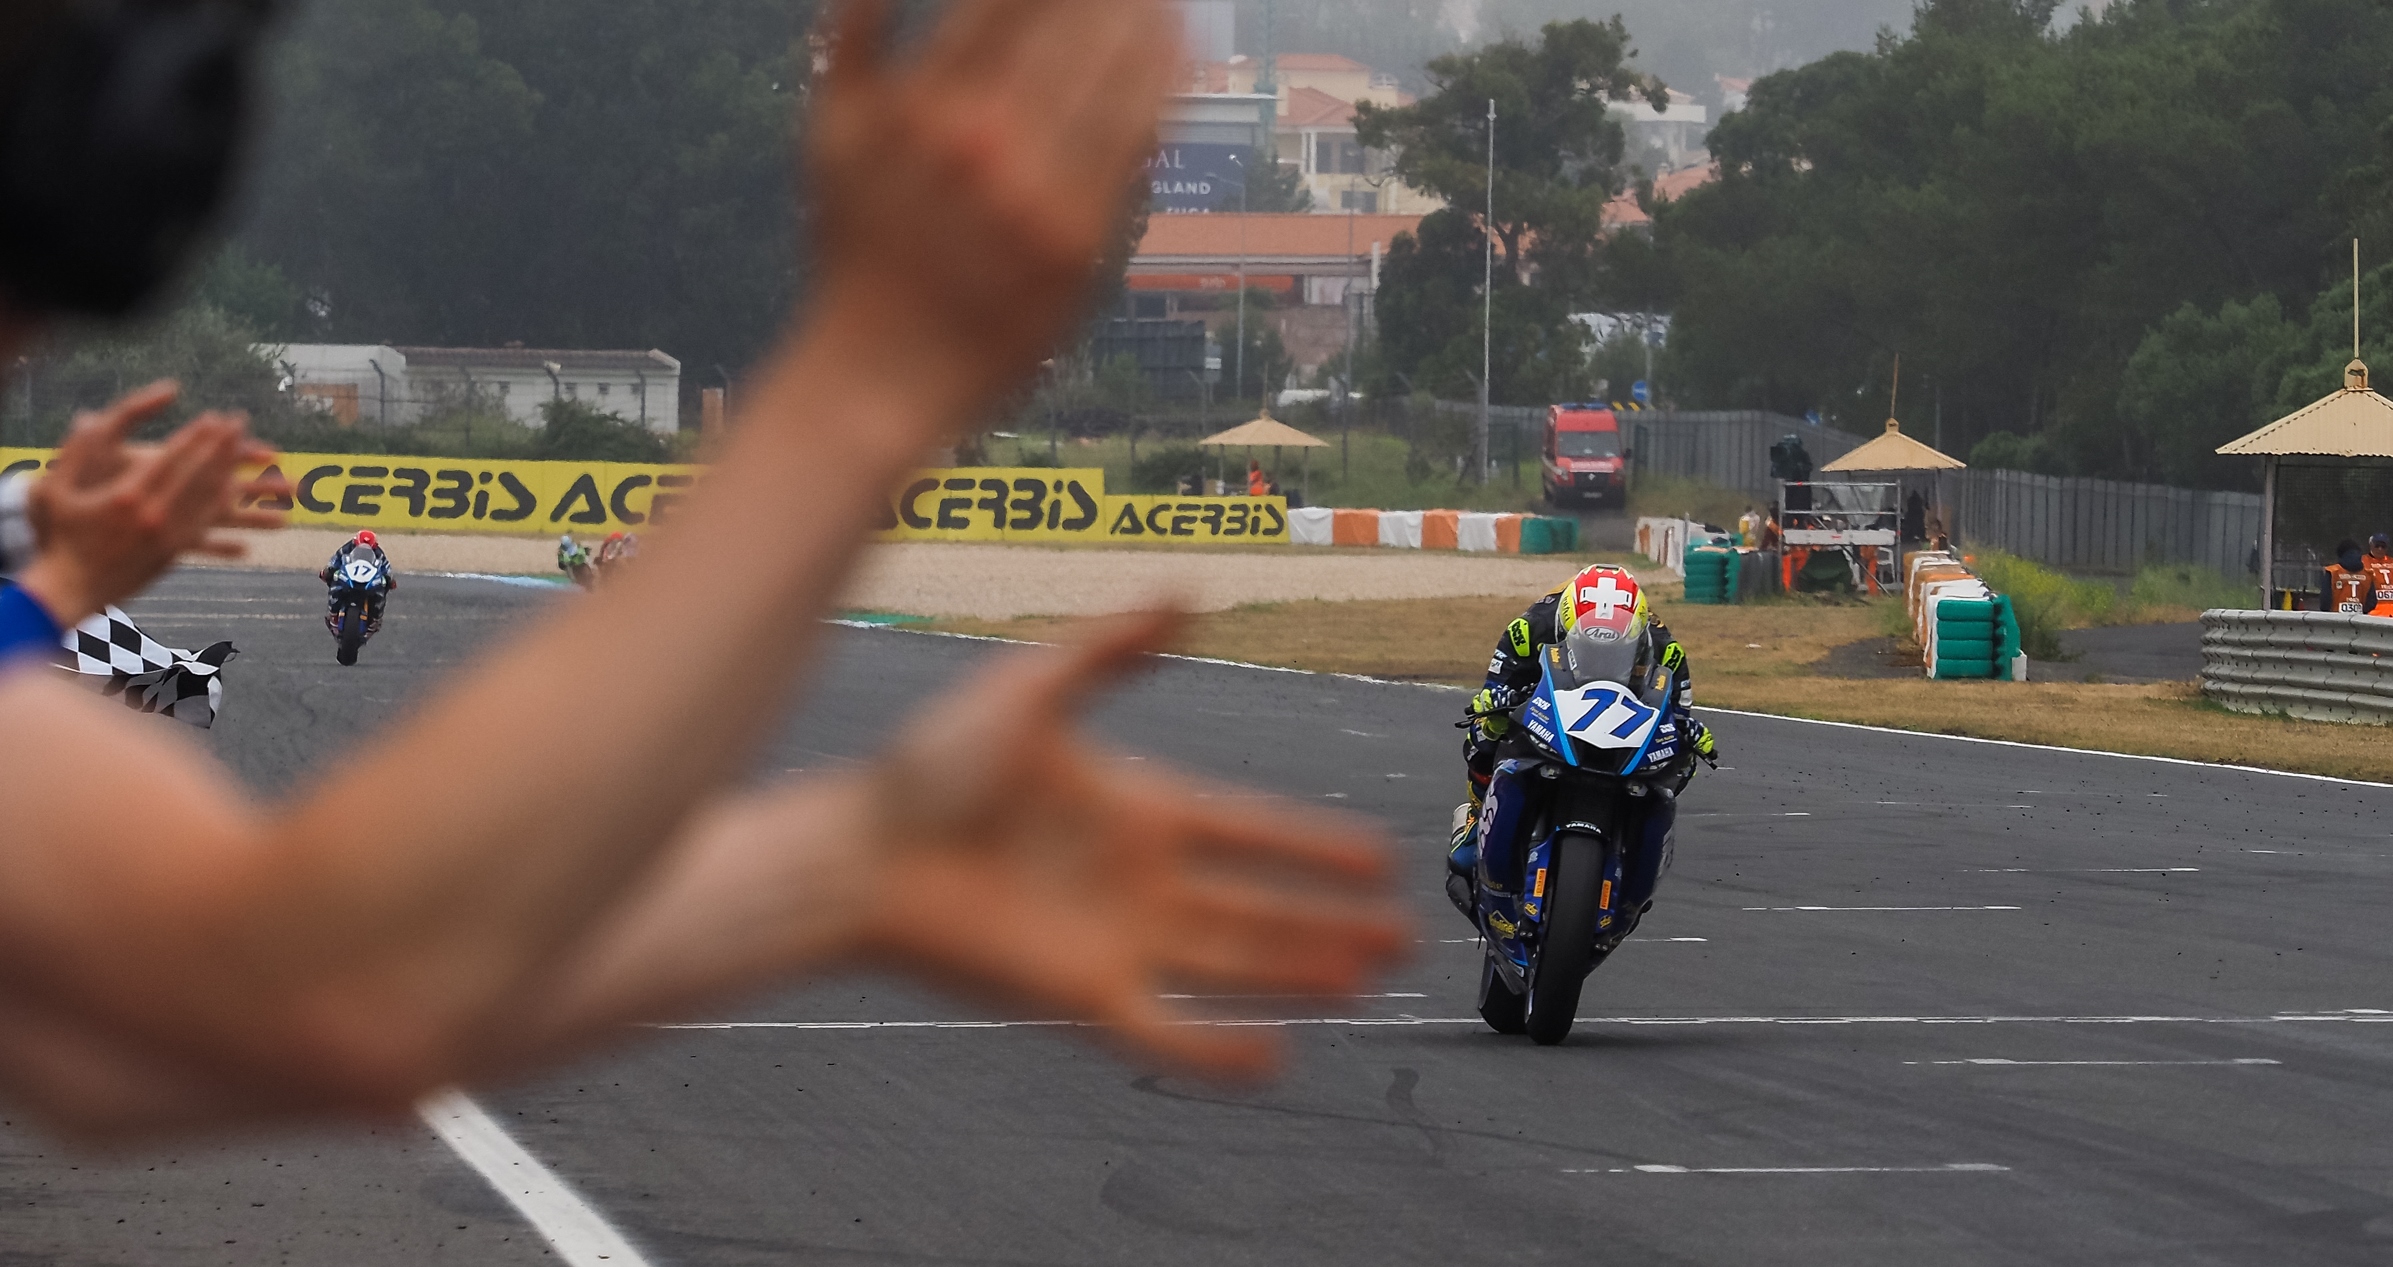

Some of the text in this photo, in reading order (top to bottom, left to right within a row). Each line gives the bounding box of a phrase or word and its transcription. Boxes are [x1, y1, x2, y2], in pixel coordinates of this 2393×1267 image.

[353, 565, 372, 577] 17
[1589, 627, 1616, 639] Arai
[1567, 688, 1656, 741] 77
[1527, 719, 1555, 743] YAMAHA
[1647, 746, 1675, 762] YAMAHA
[1565, 822, 1602, 834] YAMAHA
